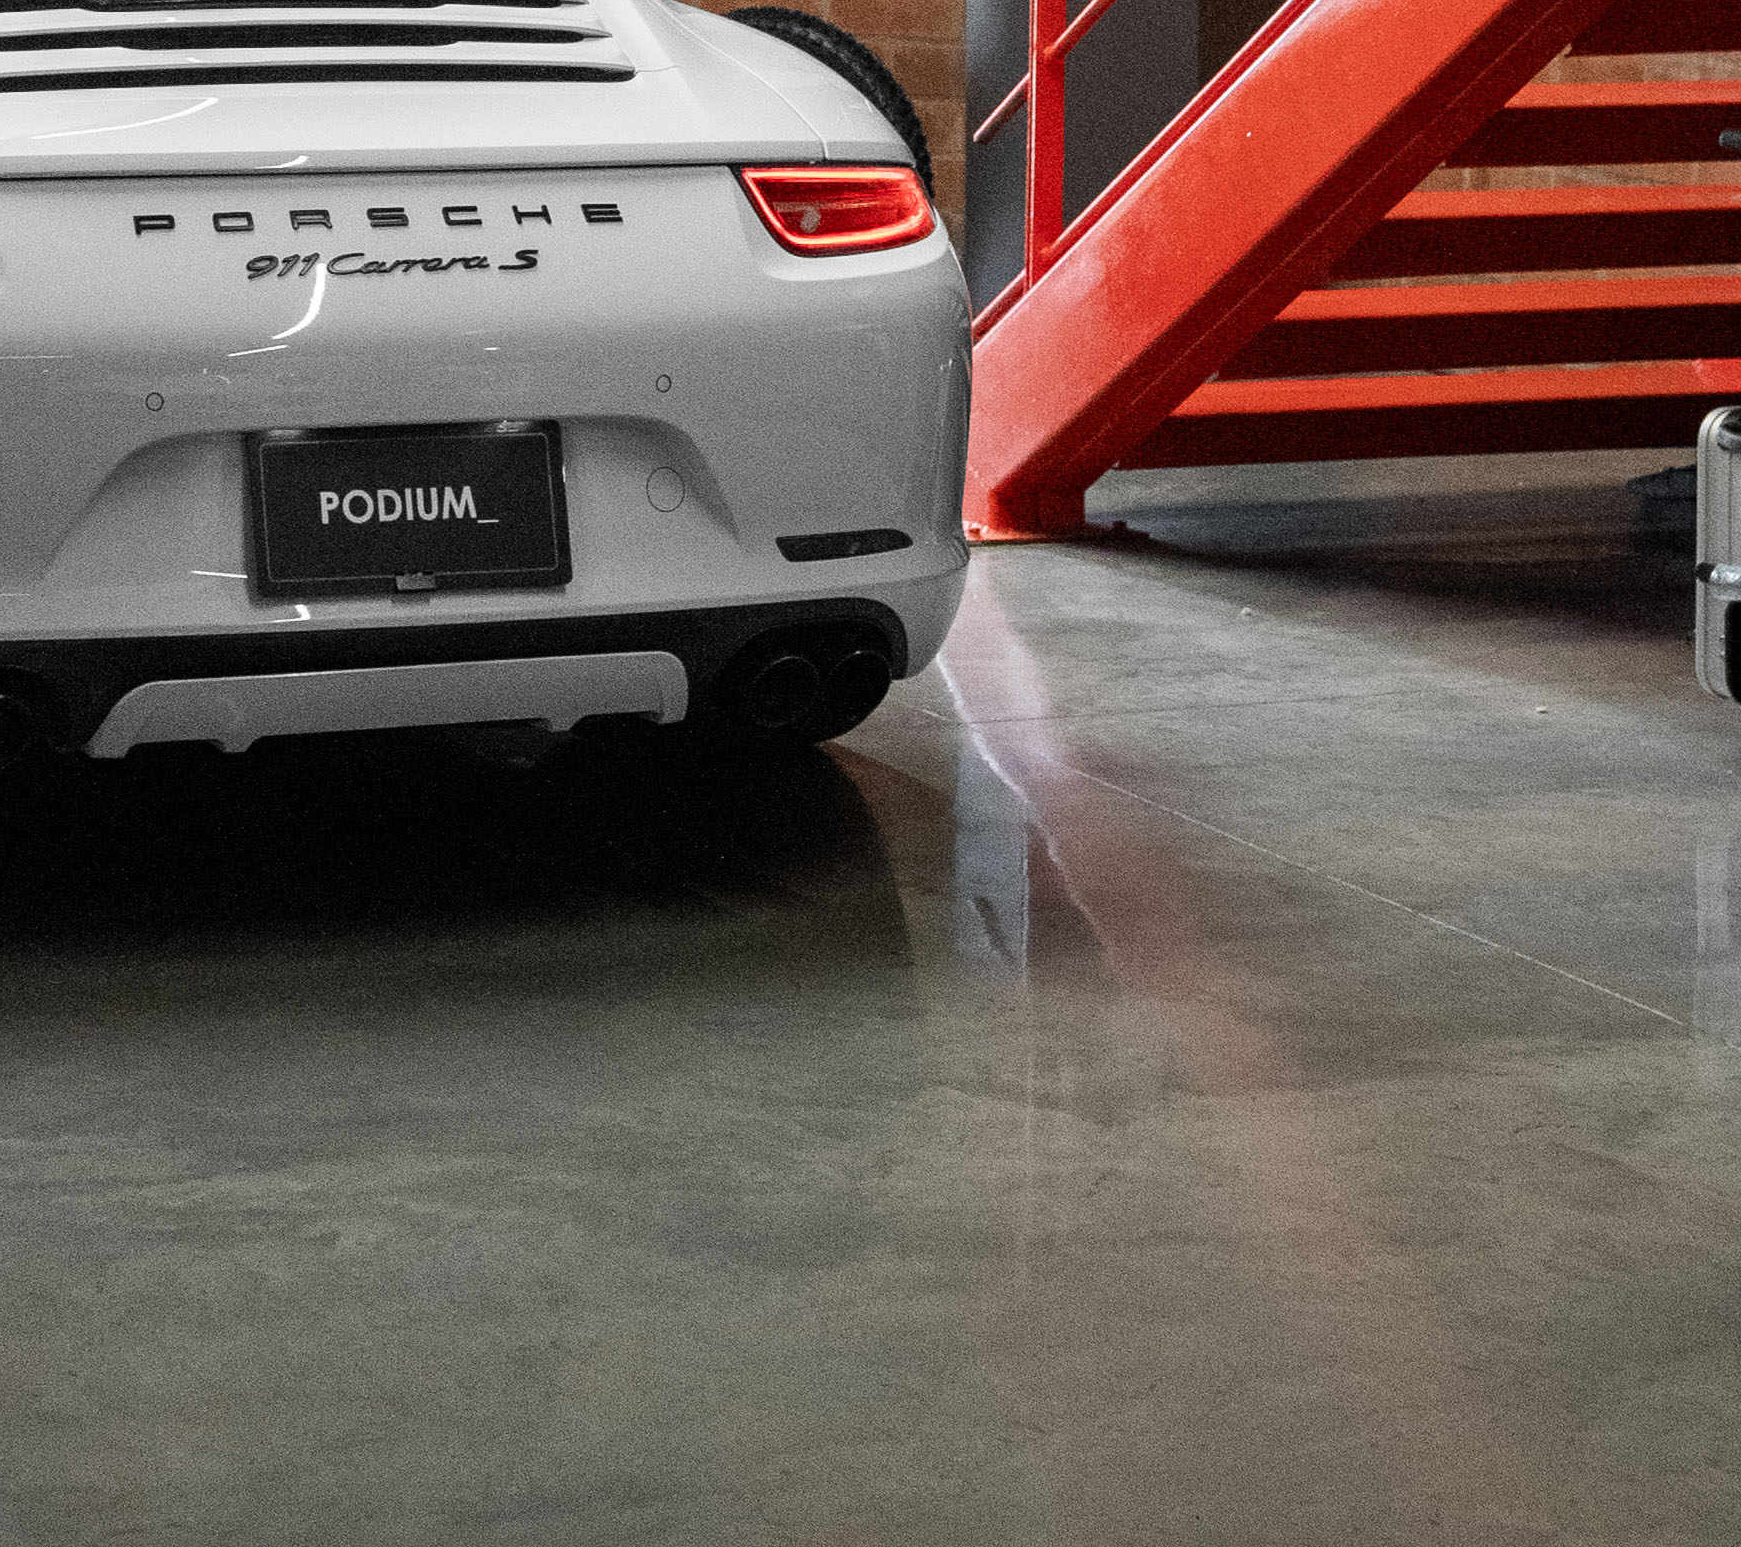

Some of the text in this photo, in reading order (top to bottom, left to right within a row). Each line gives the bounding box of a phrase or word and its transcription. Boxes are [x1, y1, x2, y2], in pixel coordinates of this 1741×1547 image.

[133, 203, 624, 235] PORSCHE
[245, 249, 539, 280] 911 Carrera S
